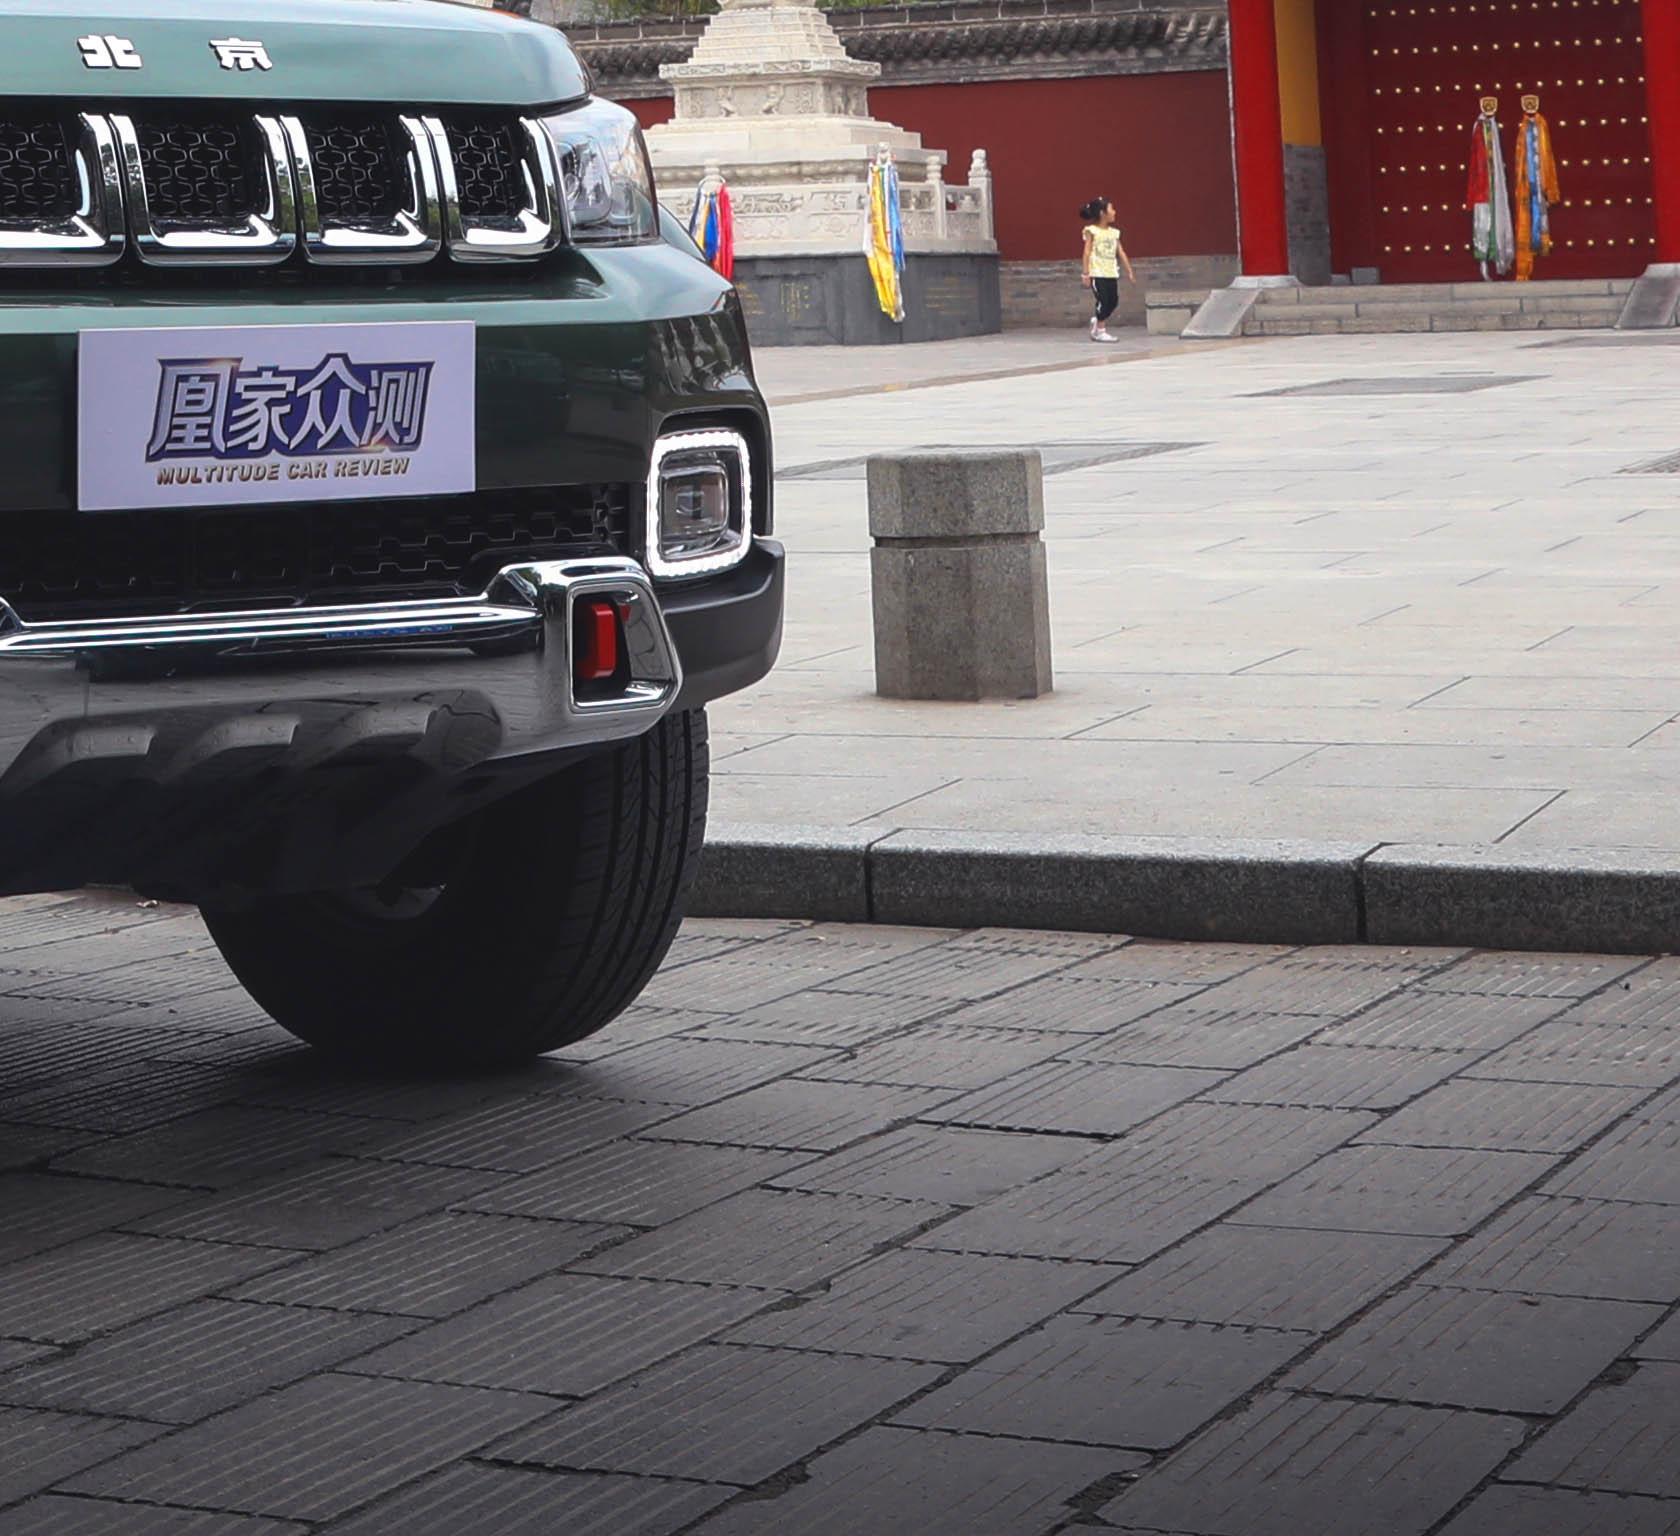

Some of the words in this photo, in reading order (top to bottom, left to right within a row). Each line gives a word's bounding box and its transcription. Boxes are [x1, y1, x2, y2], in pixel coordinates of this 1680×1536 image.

[77, 34, 273, 71] 北京
[148, 357, 428, 459] 凰家众测
[156, 462, 280, 485] MULTITUDE
[287, 460, 328, 480] CAR
[333, 457, 410, 477] REVIEW
